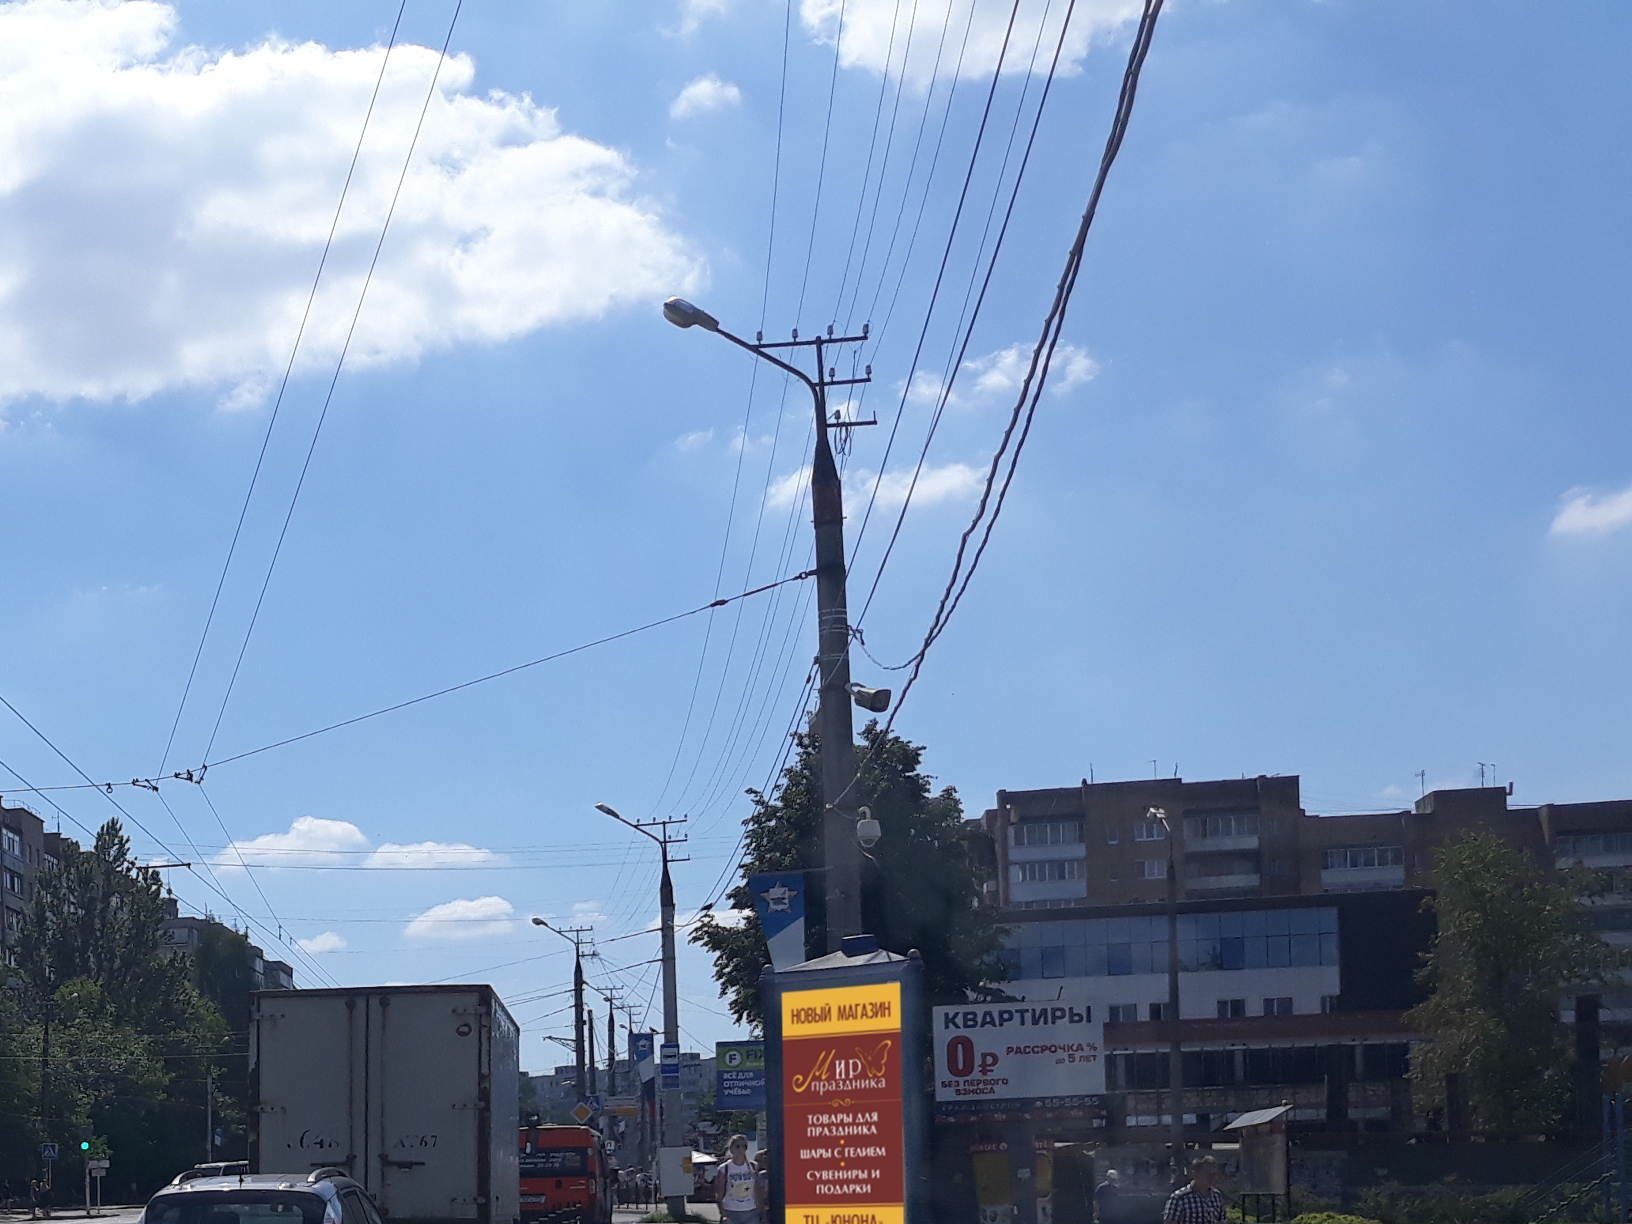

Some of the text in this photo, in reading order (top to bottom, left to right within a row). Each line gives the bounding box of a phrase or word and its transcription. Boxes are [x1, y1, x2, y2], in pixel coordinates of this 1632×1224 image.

[790, 1001, 891, 1025] НОВЫЙ МАГАЗИН
[944, 1005, 1092, 1030] КВАРТИРЫ
[1006, 1043, 1084, 1055] РАССРОЧКА
[792, 1048, 861, 1093] Мир
[811, 1078, 886, 1096] праздника
[941, 1078, 1009, 1088] БЕЗ ПЕРВОГО
[955, 1087, 996, 1096] ВЗНОСА
[807, 1112, 878, 1125] ТОВАРЫ ДЛЯ
[807, 1125, 877, 1137] ПРАЗДНИКА
[800, 1147, 886, 1160] ШАРЫ С ГЕЛИЕМ
[806, 1169, 880, 1181] СУВЕНИРЫ И
[816, 1184, 871, 1195] ПОДАРКИ
